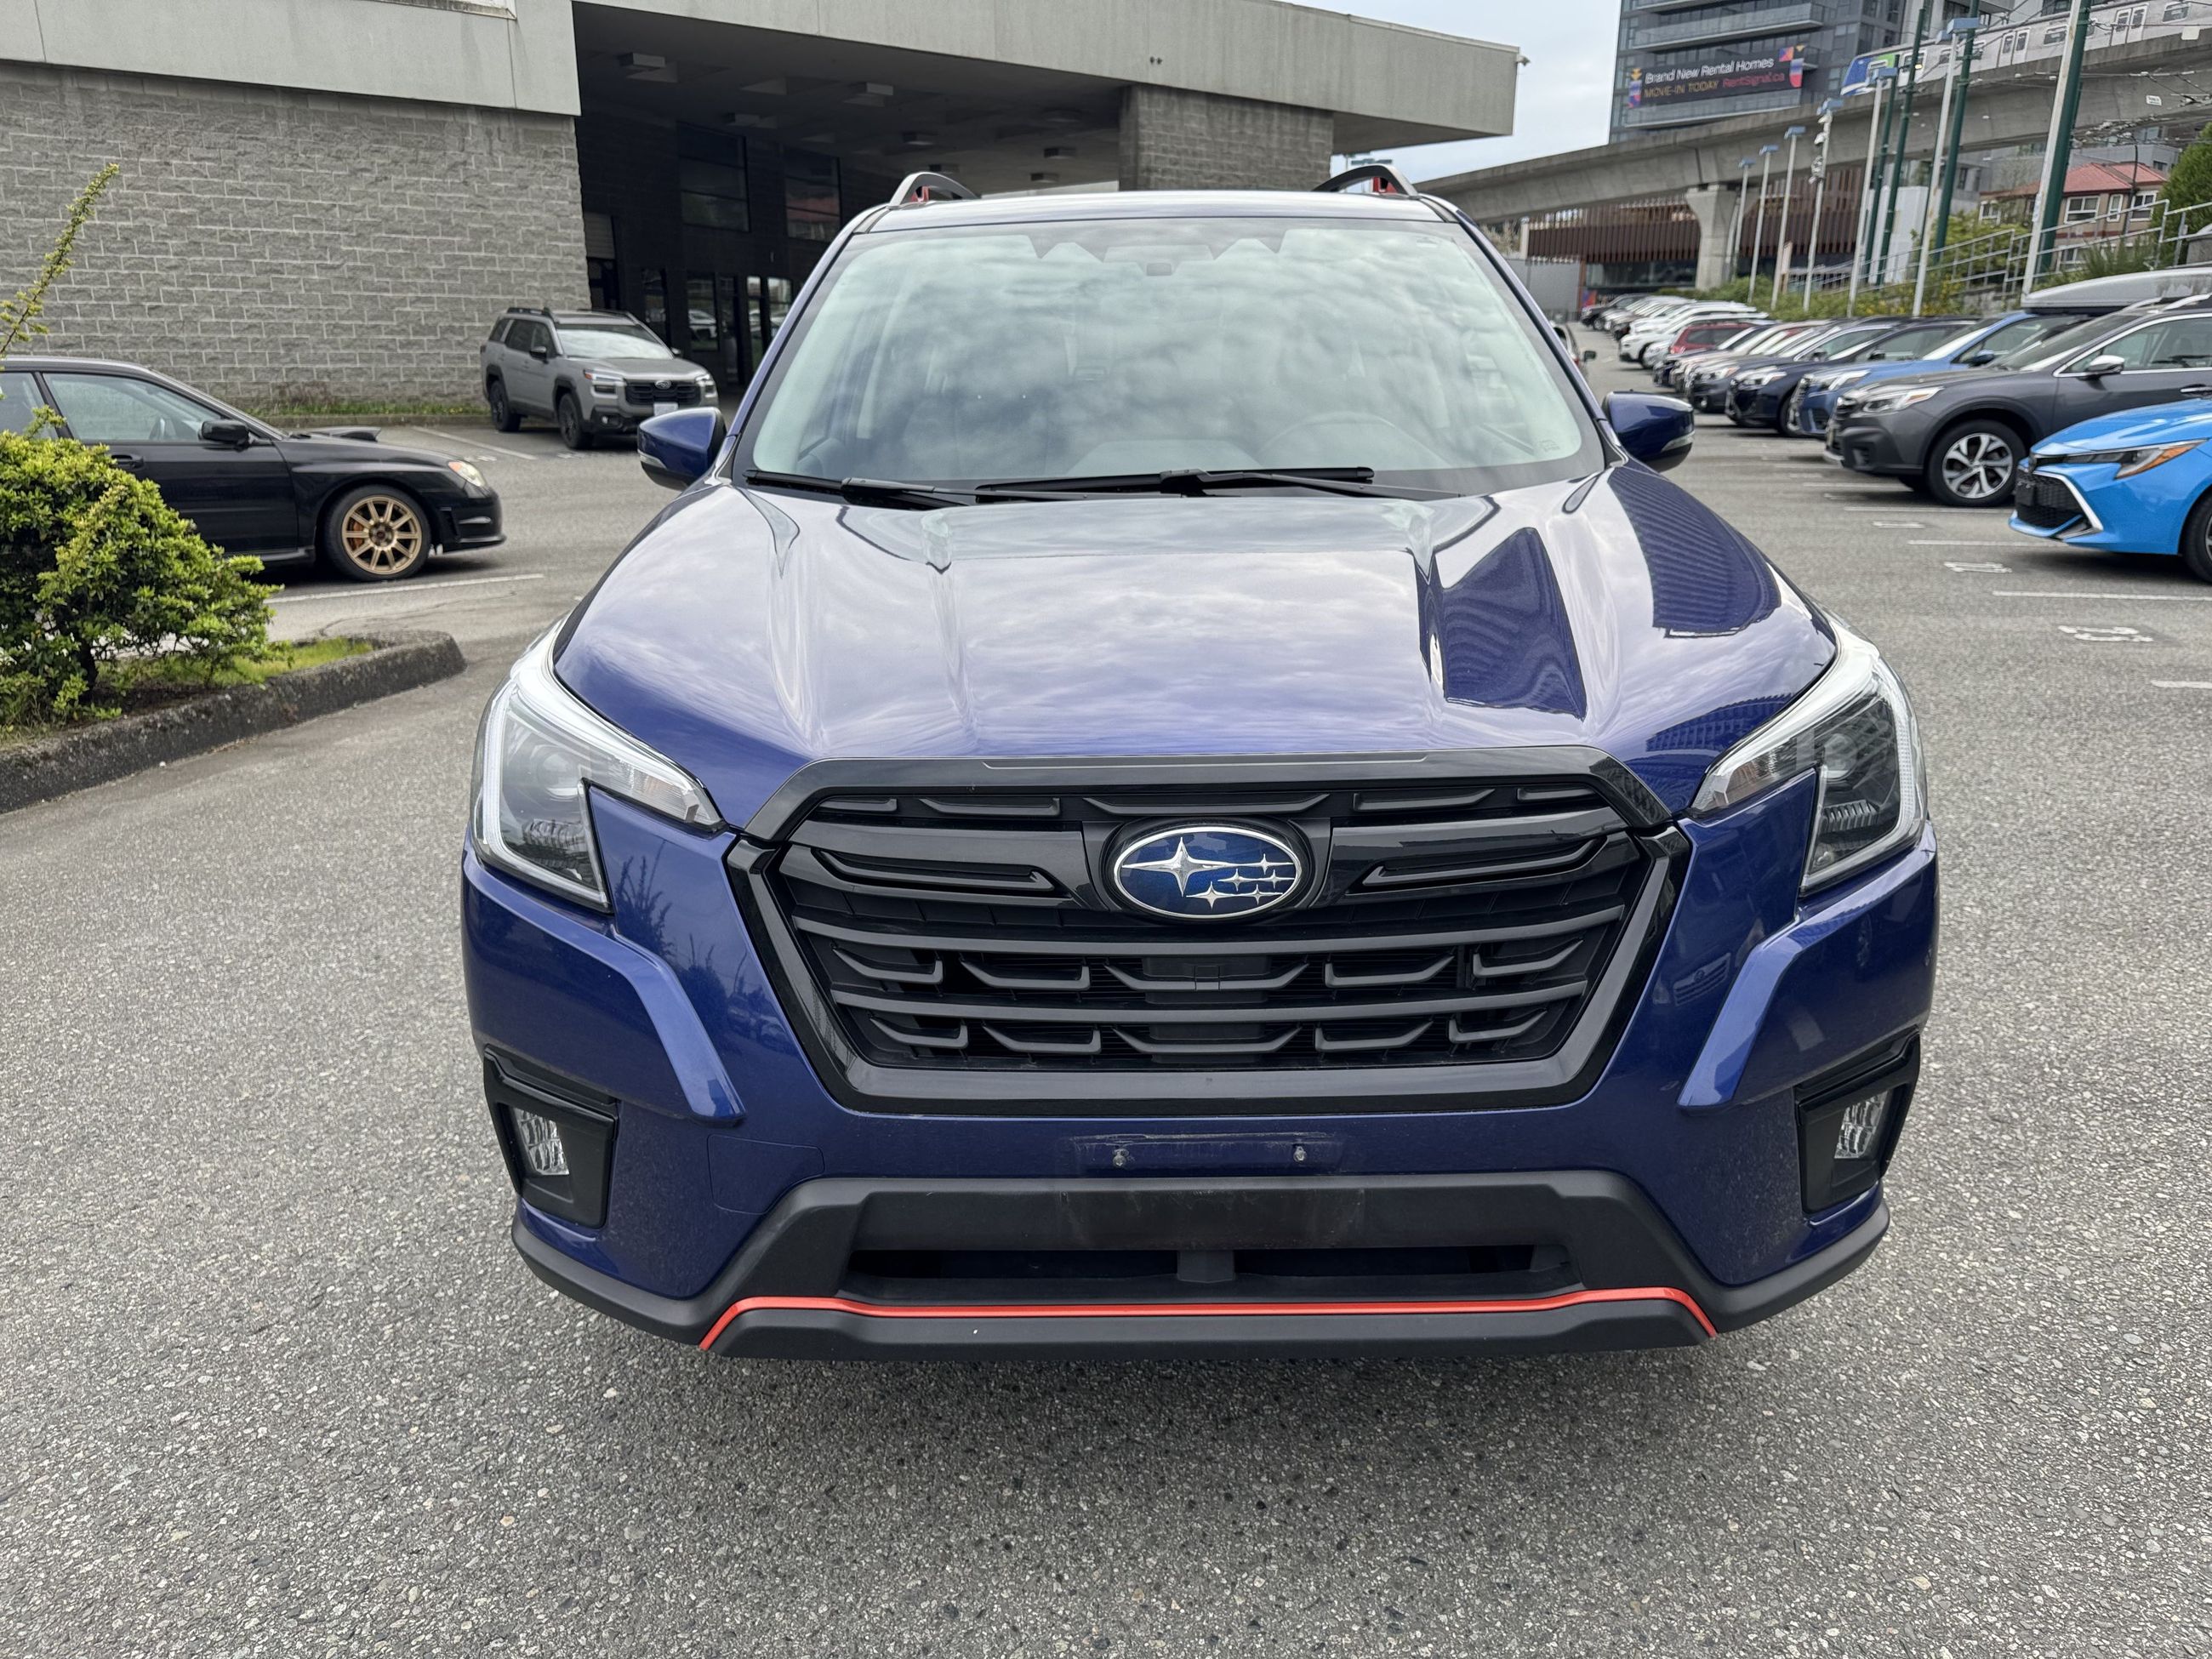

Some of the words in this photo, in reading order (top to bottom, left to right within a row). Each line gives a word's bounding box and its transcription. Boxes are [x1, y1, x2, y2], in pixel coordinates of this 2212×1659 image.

[1645, 69, 1676, 84] Brand
[1676, 67, 1700, 80] New
[1701, 60, 1734, 77] Rental
[1735, 58, 1775, 71] Homes
[1644, 83, 1685, 98] MOVE-IN
[1688, 80, 1719, 92] TODAY
